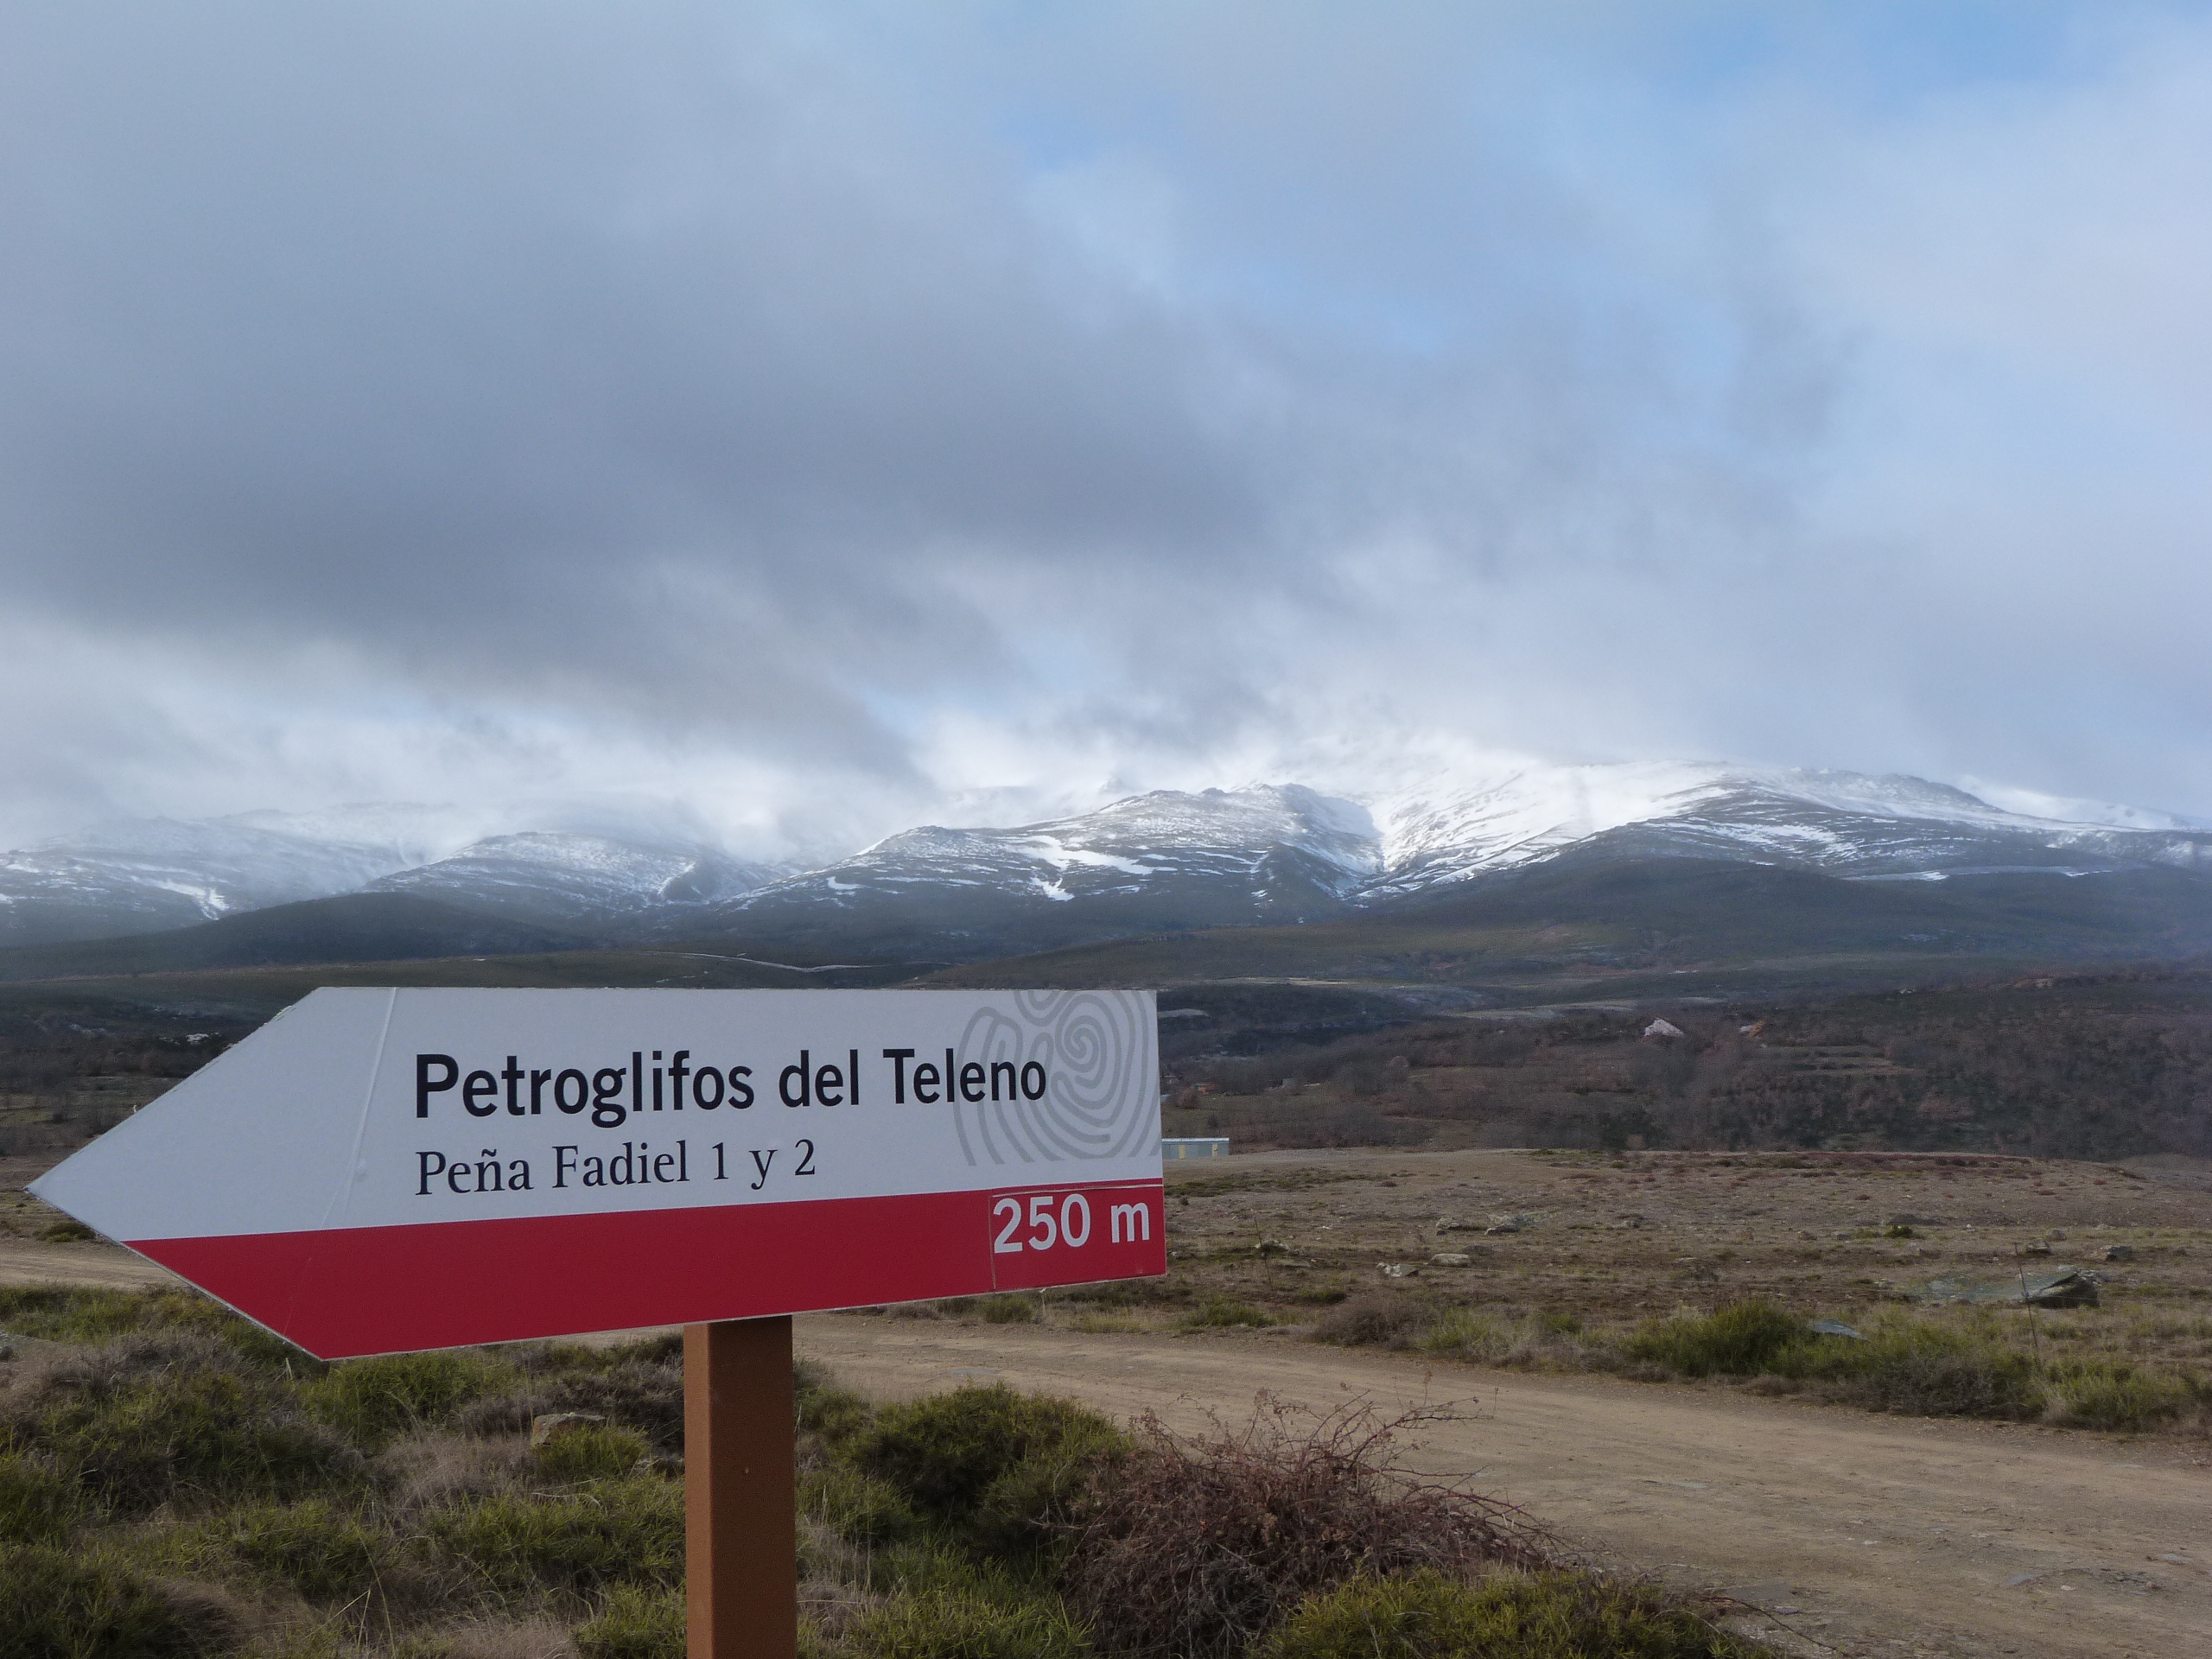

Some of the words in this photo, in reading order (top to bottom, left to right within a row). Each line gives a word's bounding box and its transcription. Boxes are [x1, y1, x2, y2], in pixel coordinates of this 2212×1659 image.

[416, 1050, 755, 1128] Petroglifos
[779, 1048, 860, 1109] del
[882, 1047, 1047, 1104] Teleno
[416, 1148, 535, 1196] Peña
[551, 1139, 690, 1189] Fadiel
[712, 1141, 729, 1180] 1
[748, 1149, 779, 1191] y
[794, 1139, 816, 1176] 2
[993, 1193, 1090, 1254] 250
[1110, 1202, 1150, 1243] m
